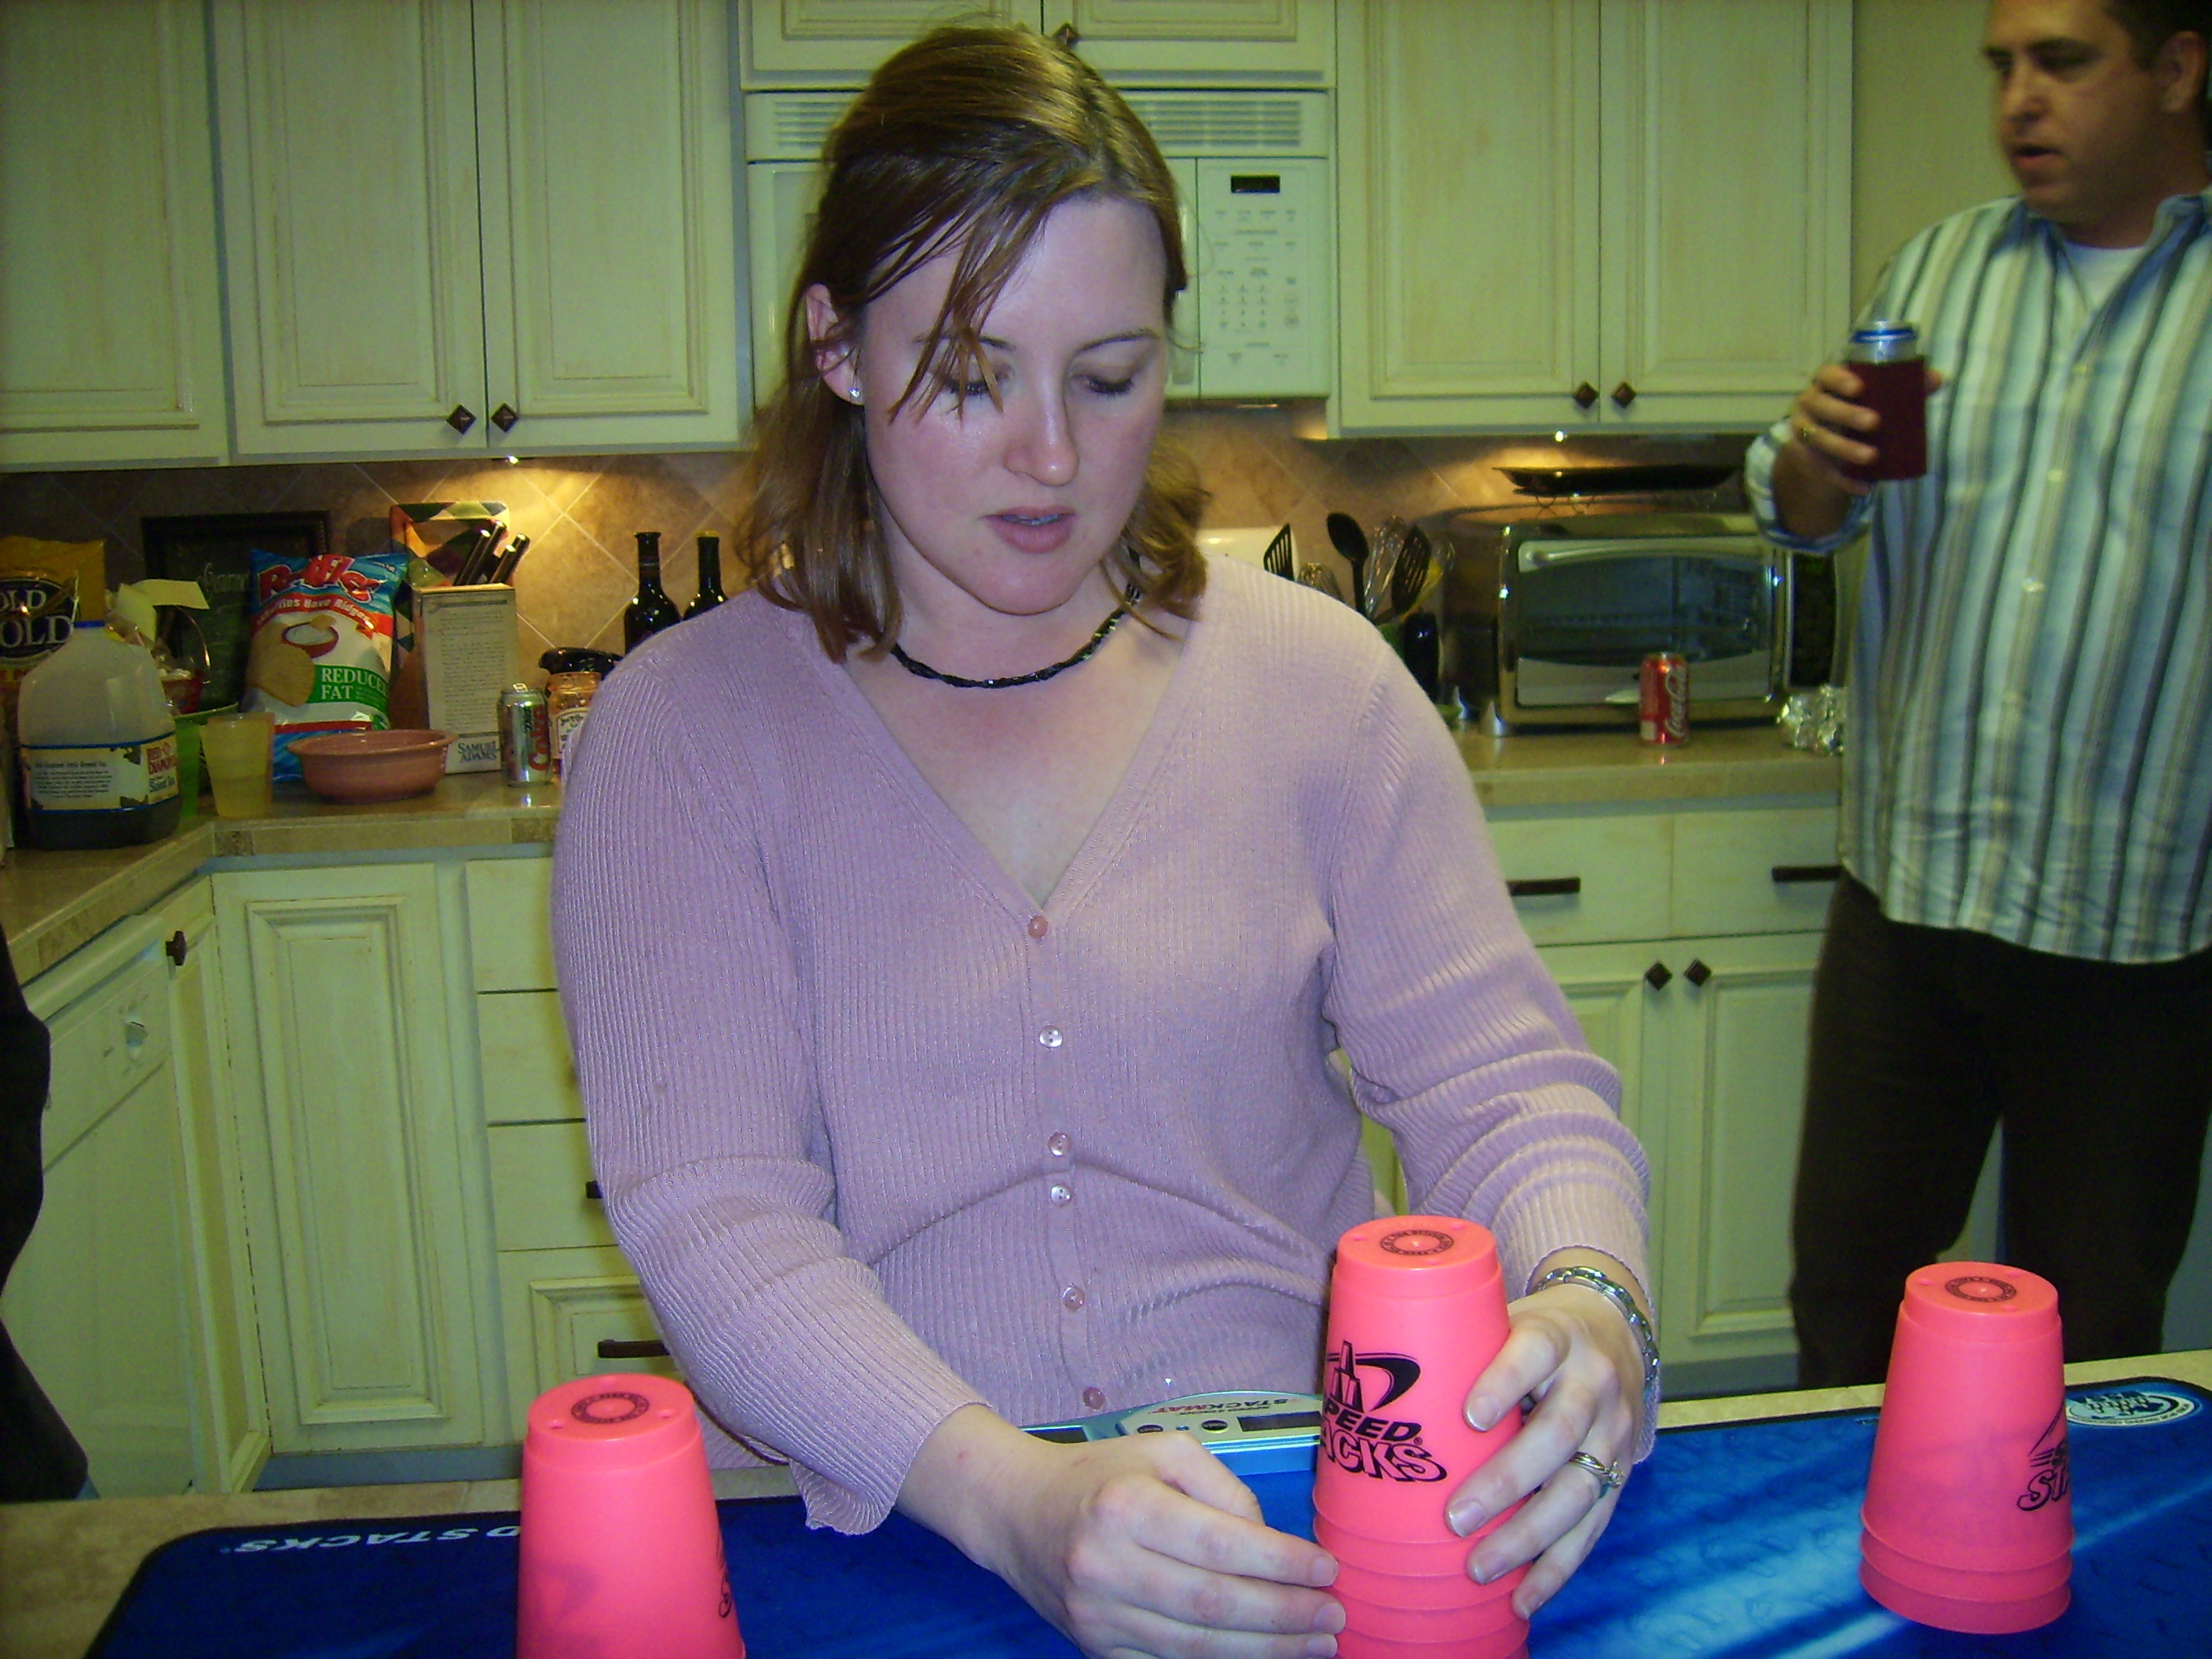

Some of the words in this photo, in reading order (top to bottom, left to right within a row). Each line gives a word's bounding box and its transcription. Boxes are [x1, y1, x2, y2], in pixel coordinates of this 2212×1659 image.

[0, 589, 47, 611] OLD
[0, 615, 74, 648] OLD
[321, 684, 353, 700] FAT
[458, 741, 500, 754] SAMUEL
[528, 705, 551, 771] Coke
[1151, 1397, 1289, 1414] STACKMAT
[1324, 1398, 1423, 1442] PEED
[1320, 1417, 1448, 1482] ACKS
[235, 1527, 479, 1554] STACKS
